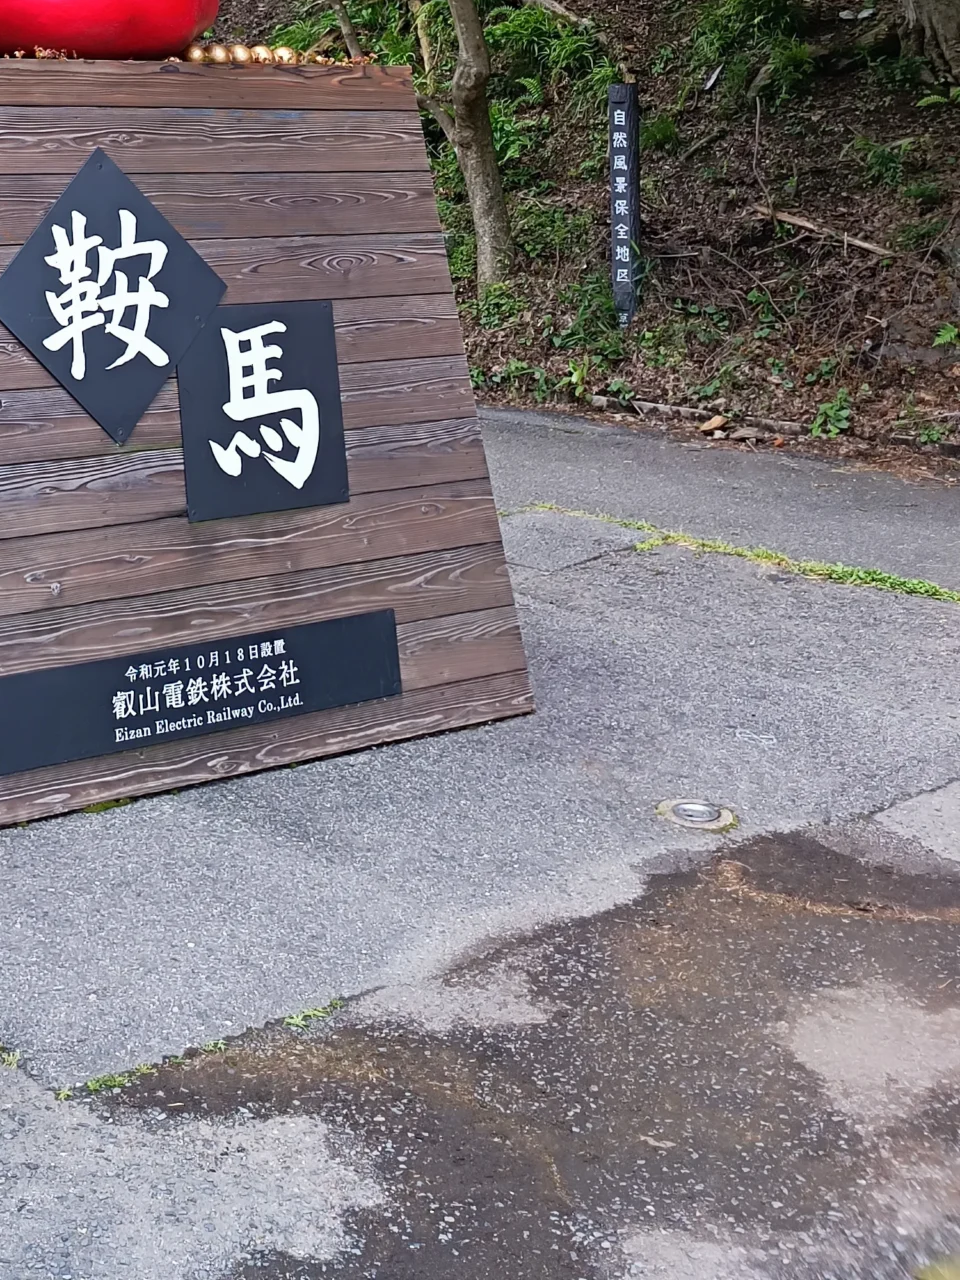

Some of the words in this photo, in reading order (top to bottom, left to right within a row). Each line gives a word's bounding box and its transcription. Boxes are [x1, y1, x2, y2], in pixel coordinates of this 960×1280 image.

[612, 109, 630, 282] 自然風景保全地区
[208, 320, 320, 490] 馬
[111, 659, 301, 720] 叡山電鉄株式会社
[124, 638, 287, 683] 令和元年10月18日設置
[114, 724, 152, 743] Eizan
[155, 713, 204, 735] Electric
[206, 705, 255, 724] Railway
